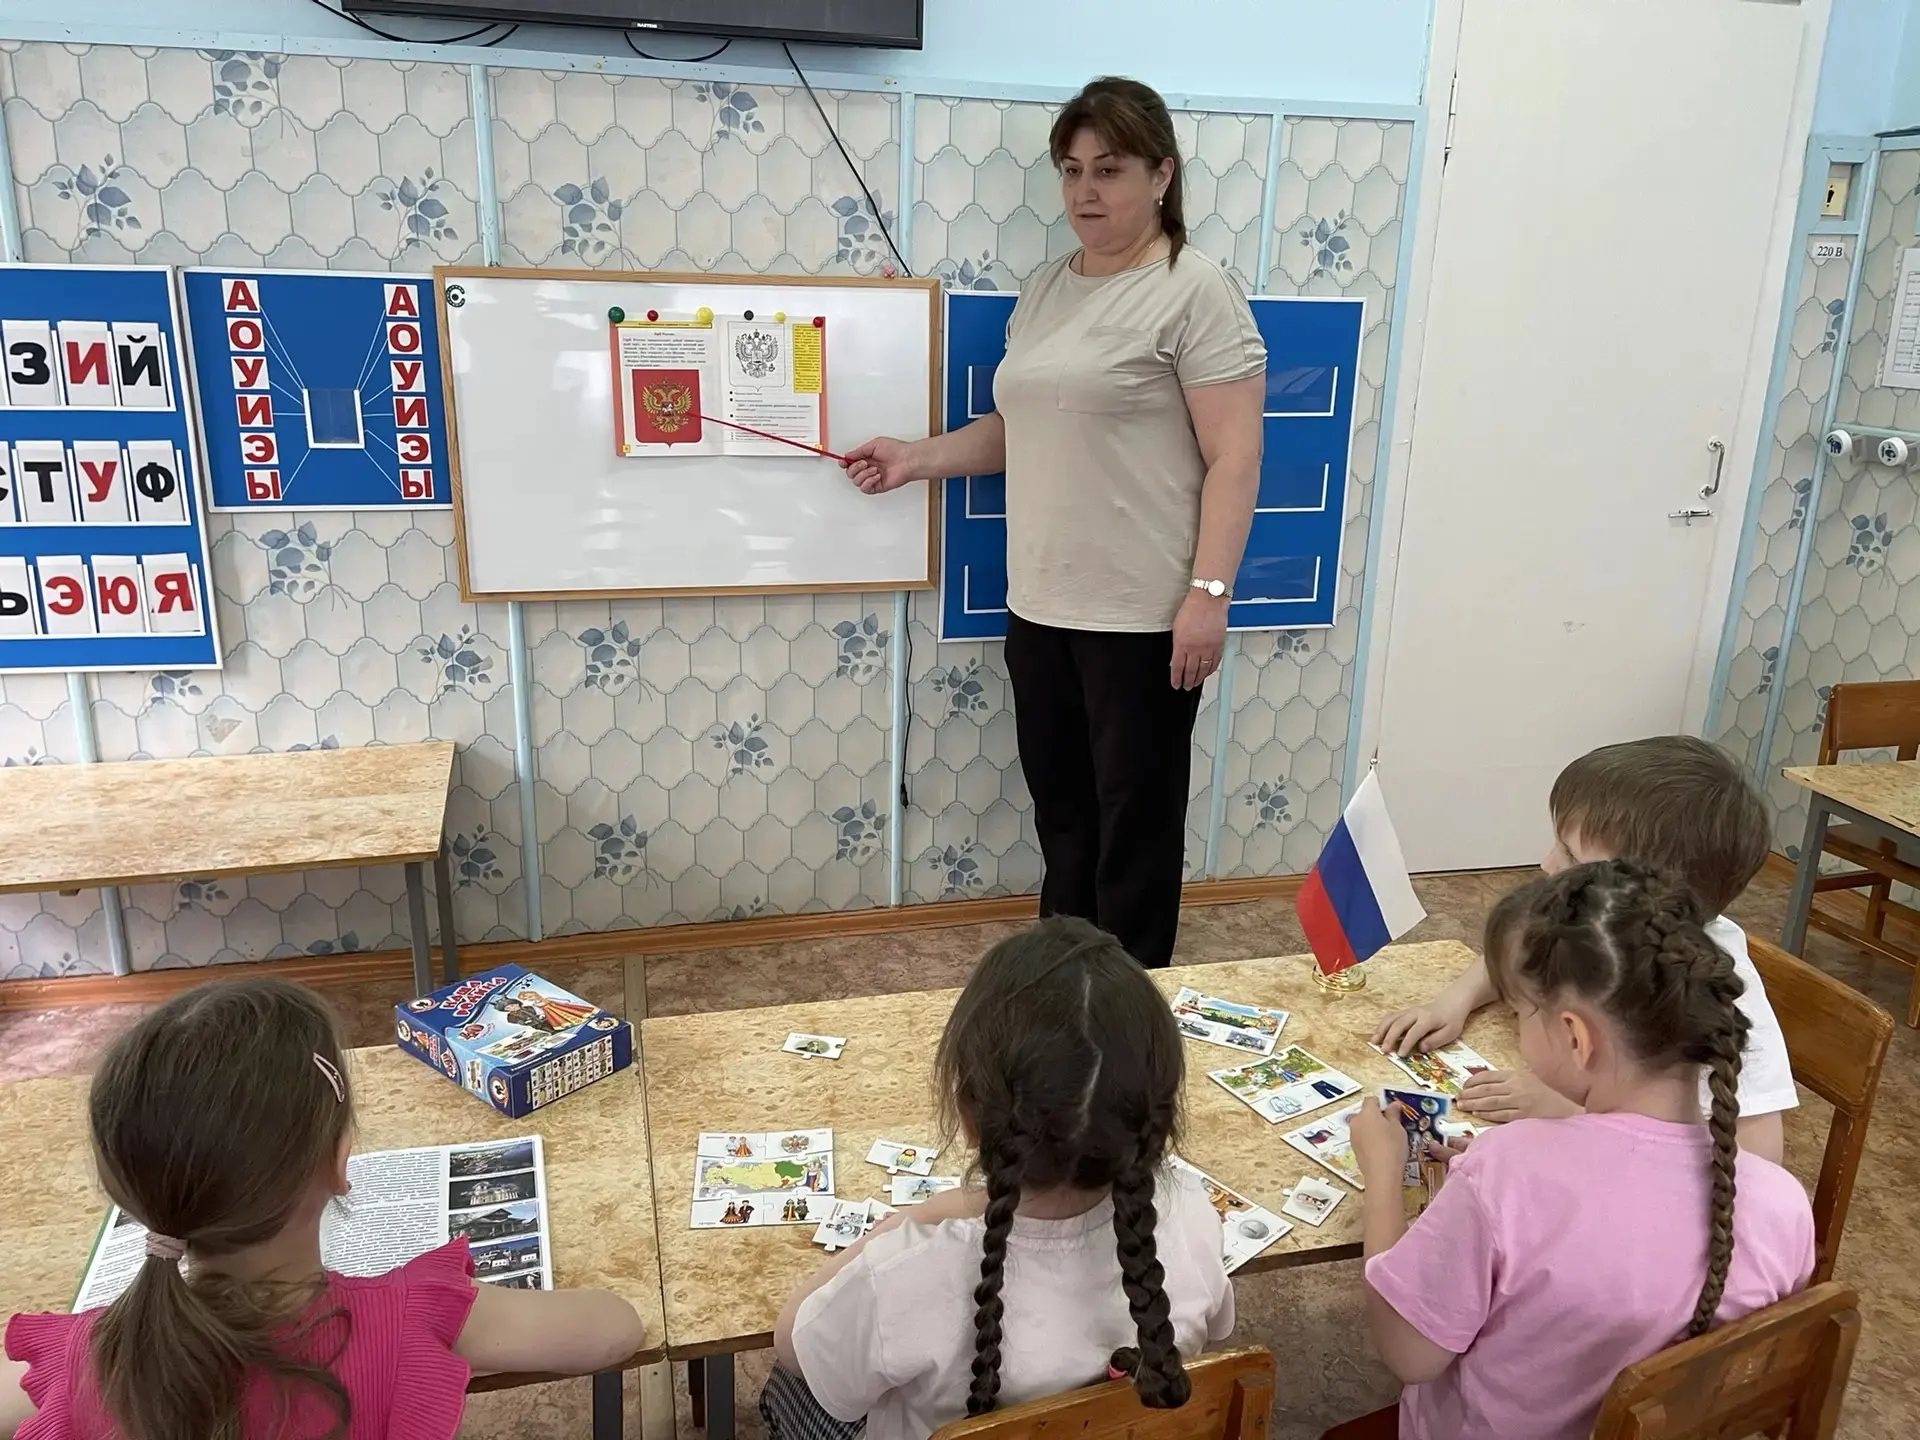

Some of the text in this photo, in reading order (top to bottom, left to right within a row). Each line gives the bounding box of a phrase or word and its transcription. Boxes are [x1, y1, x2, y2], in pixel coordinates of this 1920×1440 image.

[1817, 246, 1843, 257] 220 В
[65, 341, 110, 385] И
[118, 334, 162, 387] Й
[229, 281, 280, 500] А О У И Э Ы
[389, 286, 432, 498] А О У И Э Ы
[23, 461, 63, 503] Т
[80, 461, 118, 503] У
[136, 462, 175, 503] Ф
[46, 576, 84, 616] Э
[97, 576, 138, 615] Ю
[153, 572, 195, 614] Я
